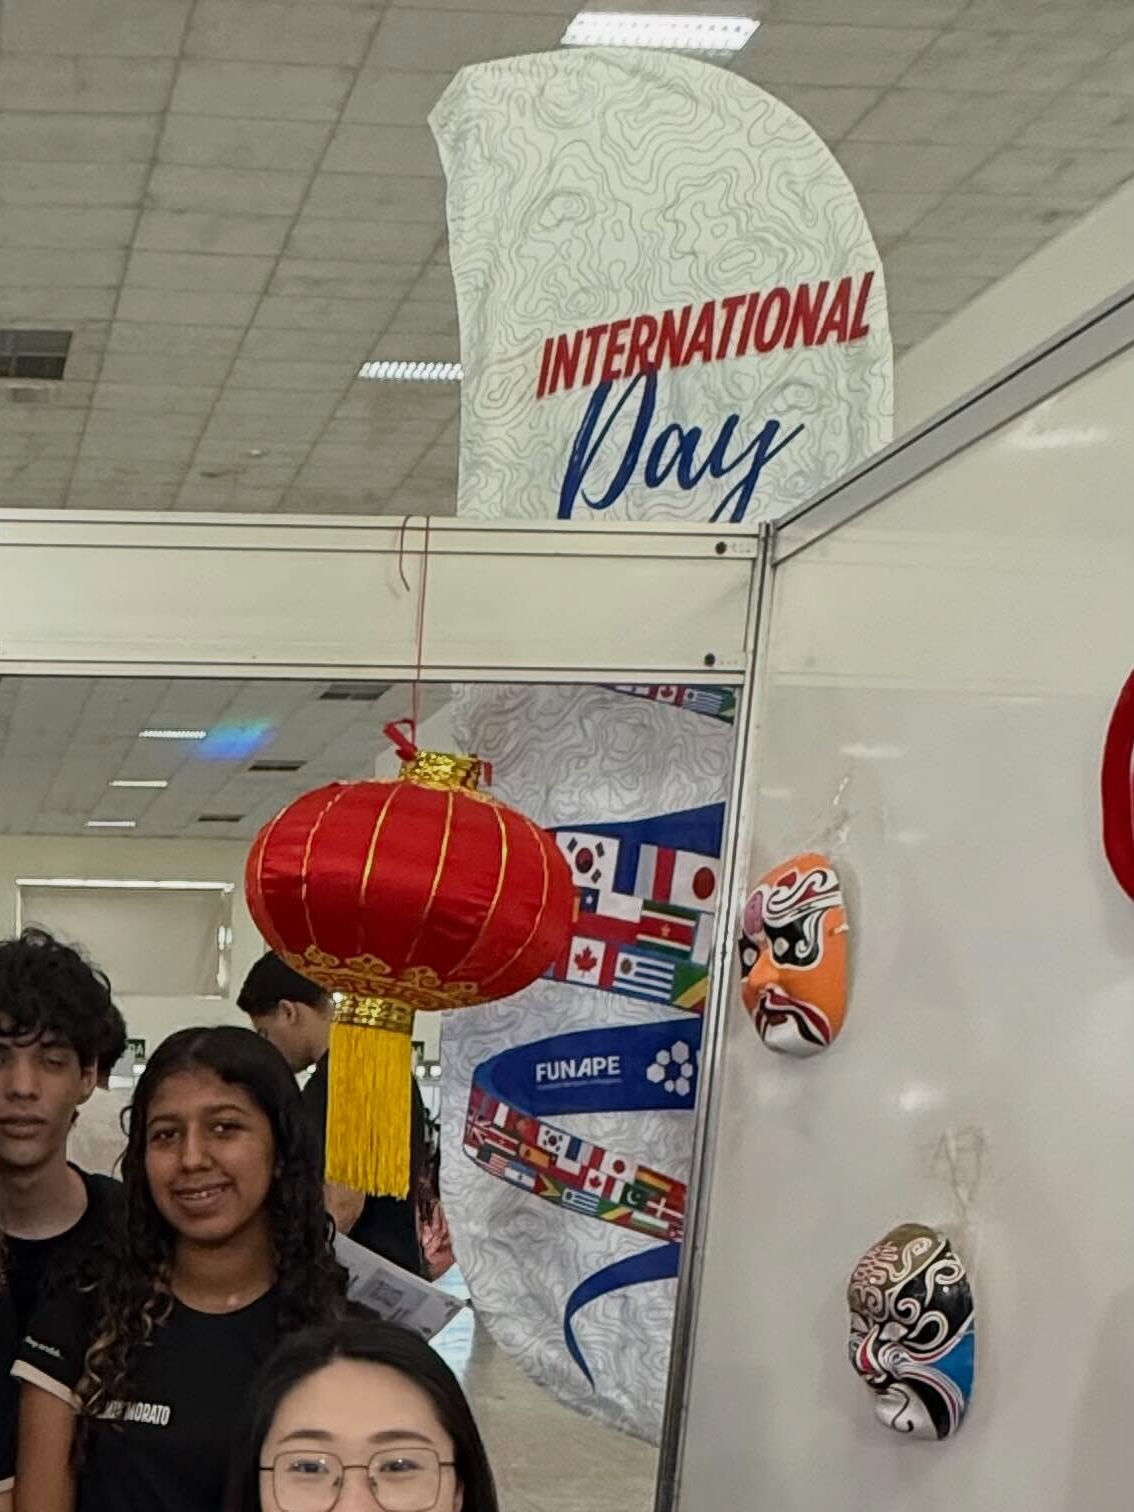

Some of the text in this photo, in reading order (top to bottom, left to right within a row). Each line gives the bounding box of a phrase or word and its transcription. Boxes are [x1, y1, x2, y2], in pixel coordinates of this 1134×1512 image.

[536, 271, 875, 400] INTERNATIONAL
[556, 362, 805, 523] Day
[535, 1056, 621, 1082] FUNAPE
